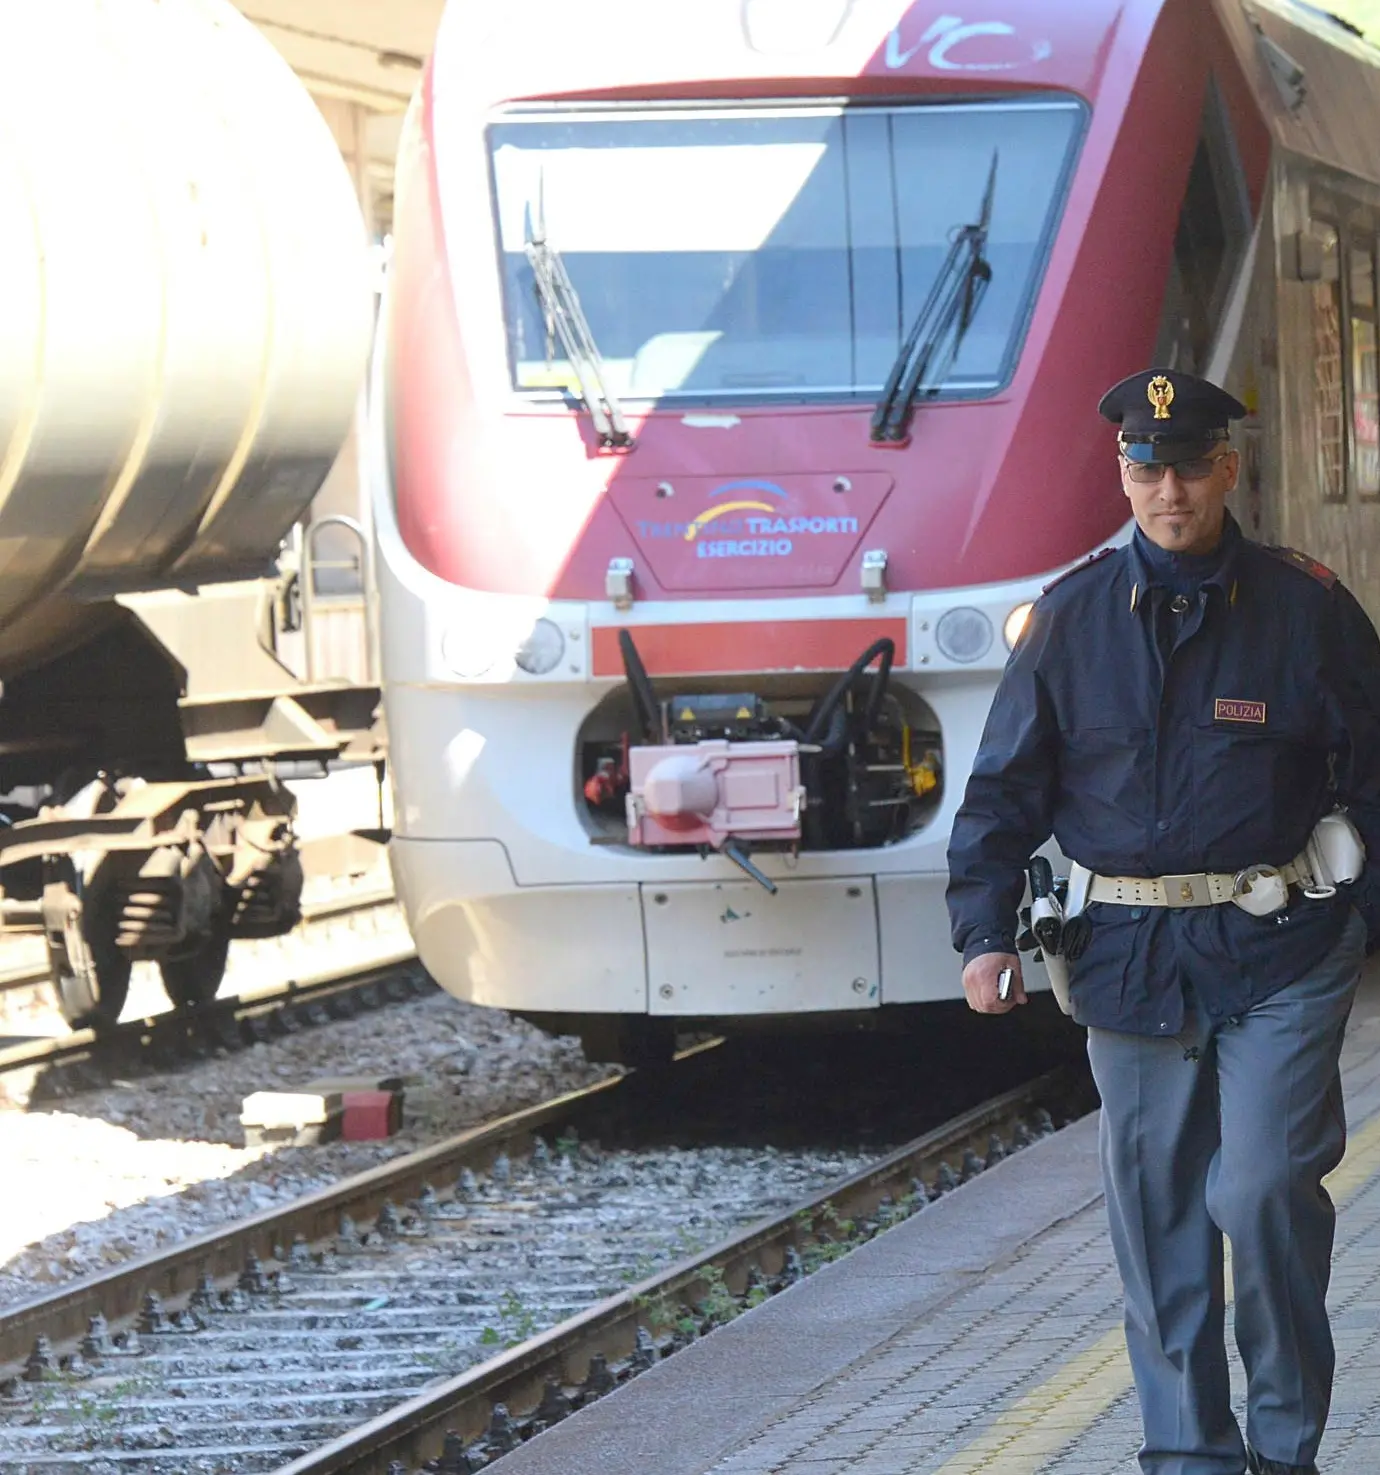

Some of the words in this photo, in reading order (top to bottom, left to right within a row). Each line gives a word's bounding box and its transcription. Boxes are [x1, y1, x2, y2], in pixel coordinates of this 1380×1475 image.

[745, 517, 858, 534] TRASPORTI
[696, 540, 792, 558] ESERCIZIO
[1218, 704, 1262, 718] POLIZIA
